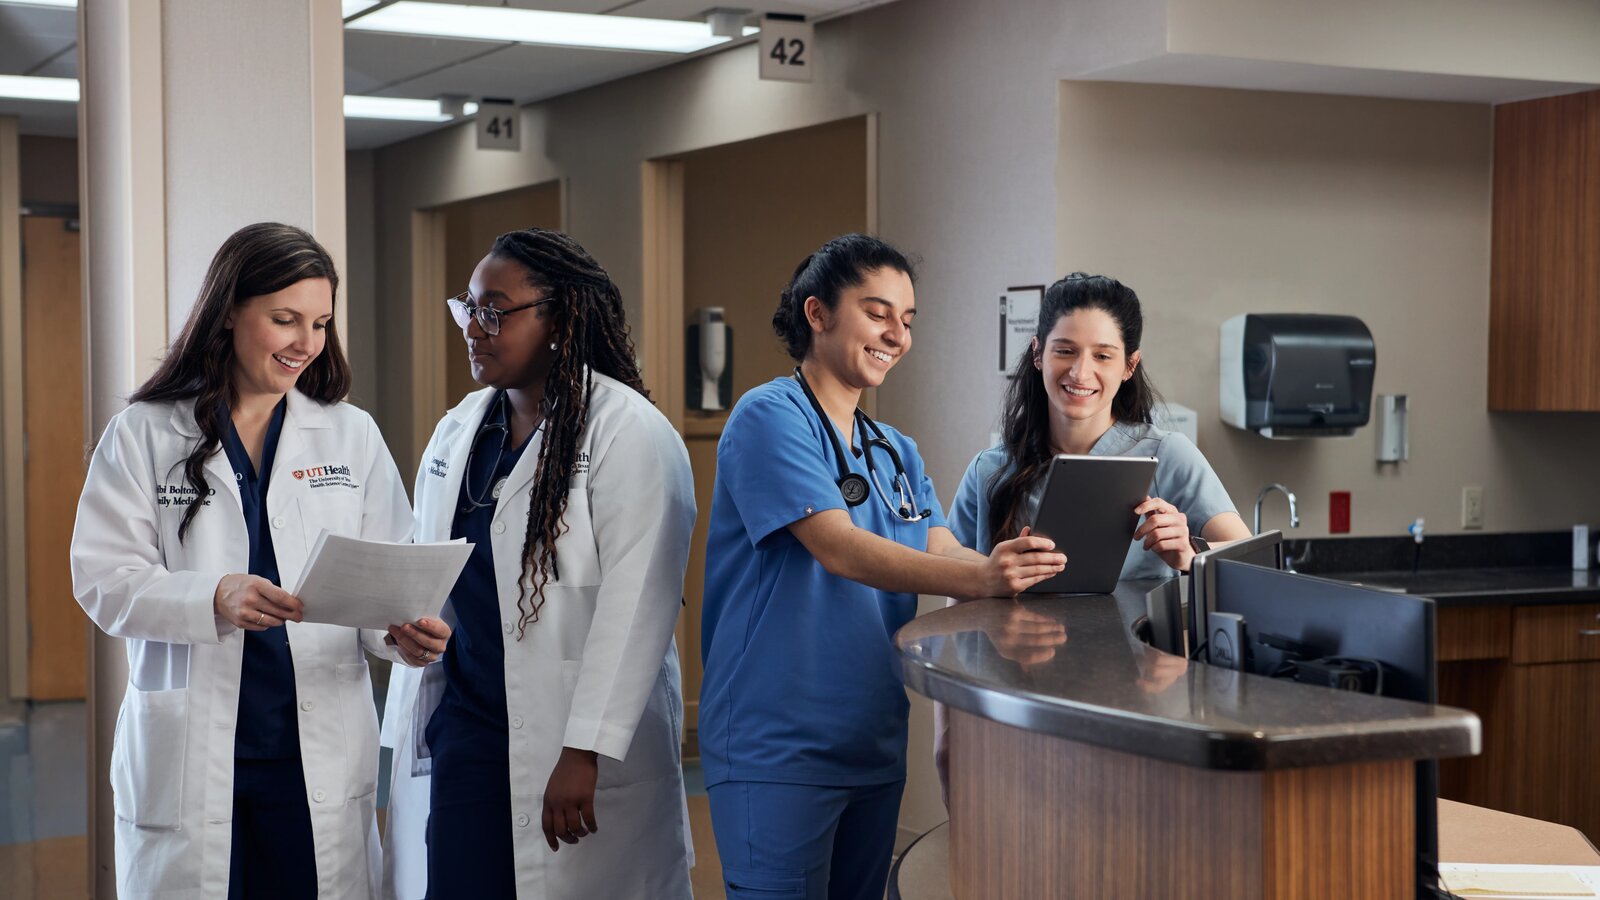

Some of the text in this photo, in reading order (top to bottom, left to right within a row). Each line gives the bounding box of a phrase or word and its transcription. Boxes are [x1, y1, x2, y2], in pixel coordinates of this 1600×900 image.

[770, 37, 805, 66] 42
[486, 116, 513, 139] 41
[173, 497, 211, 506] Medine
